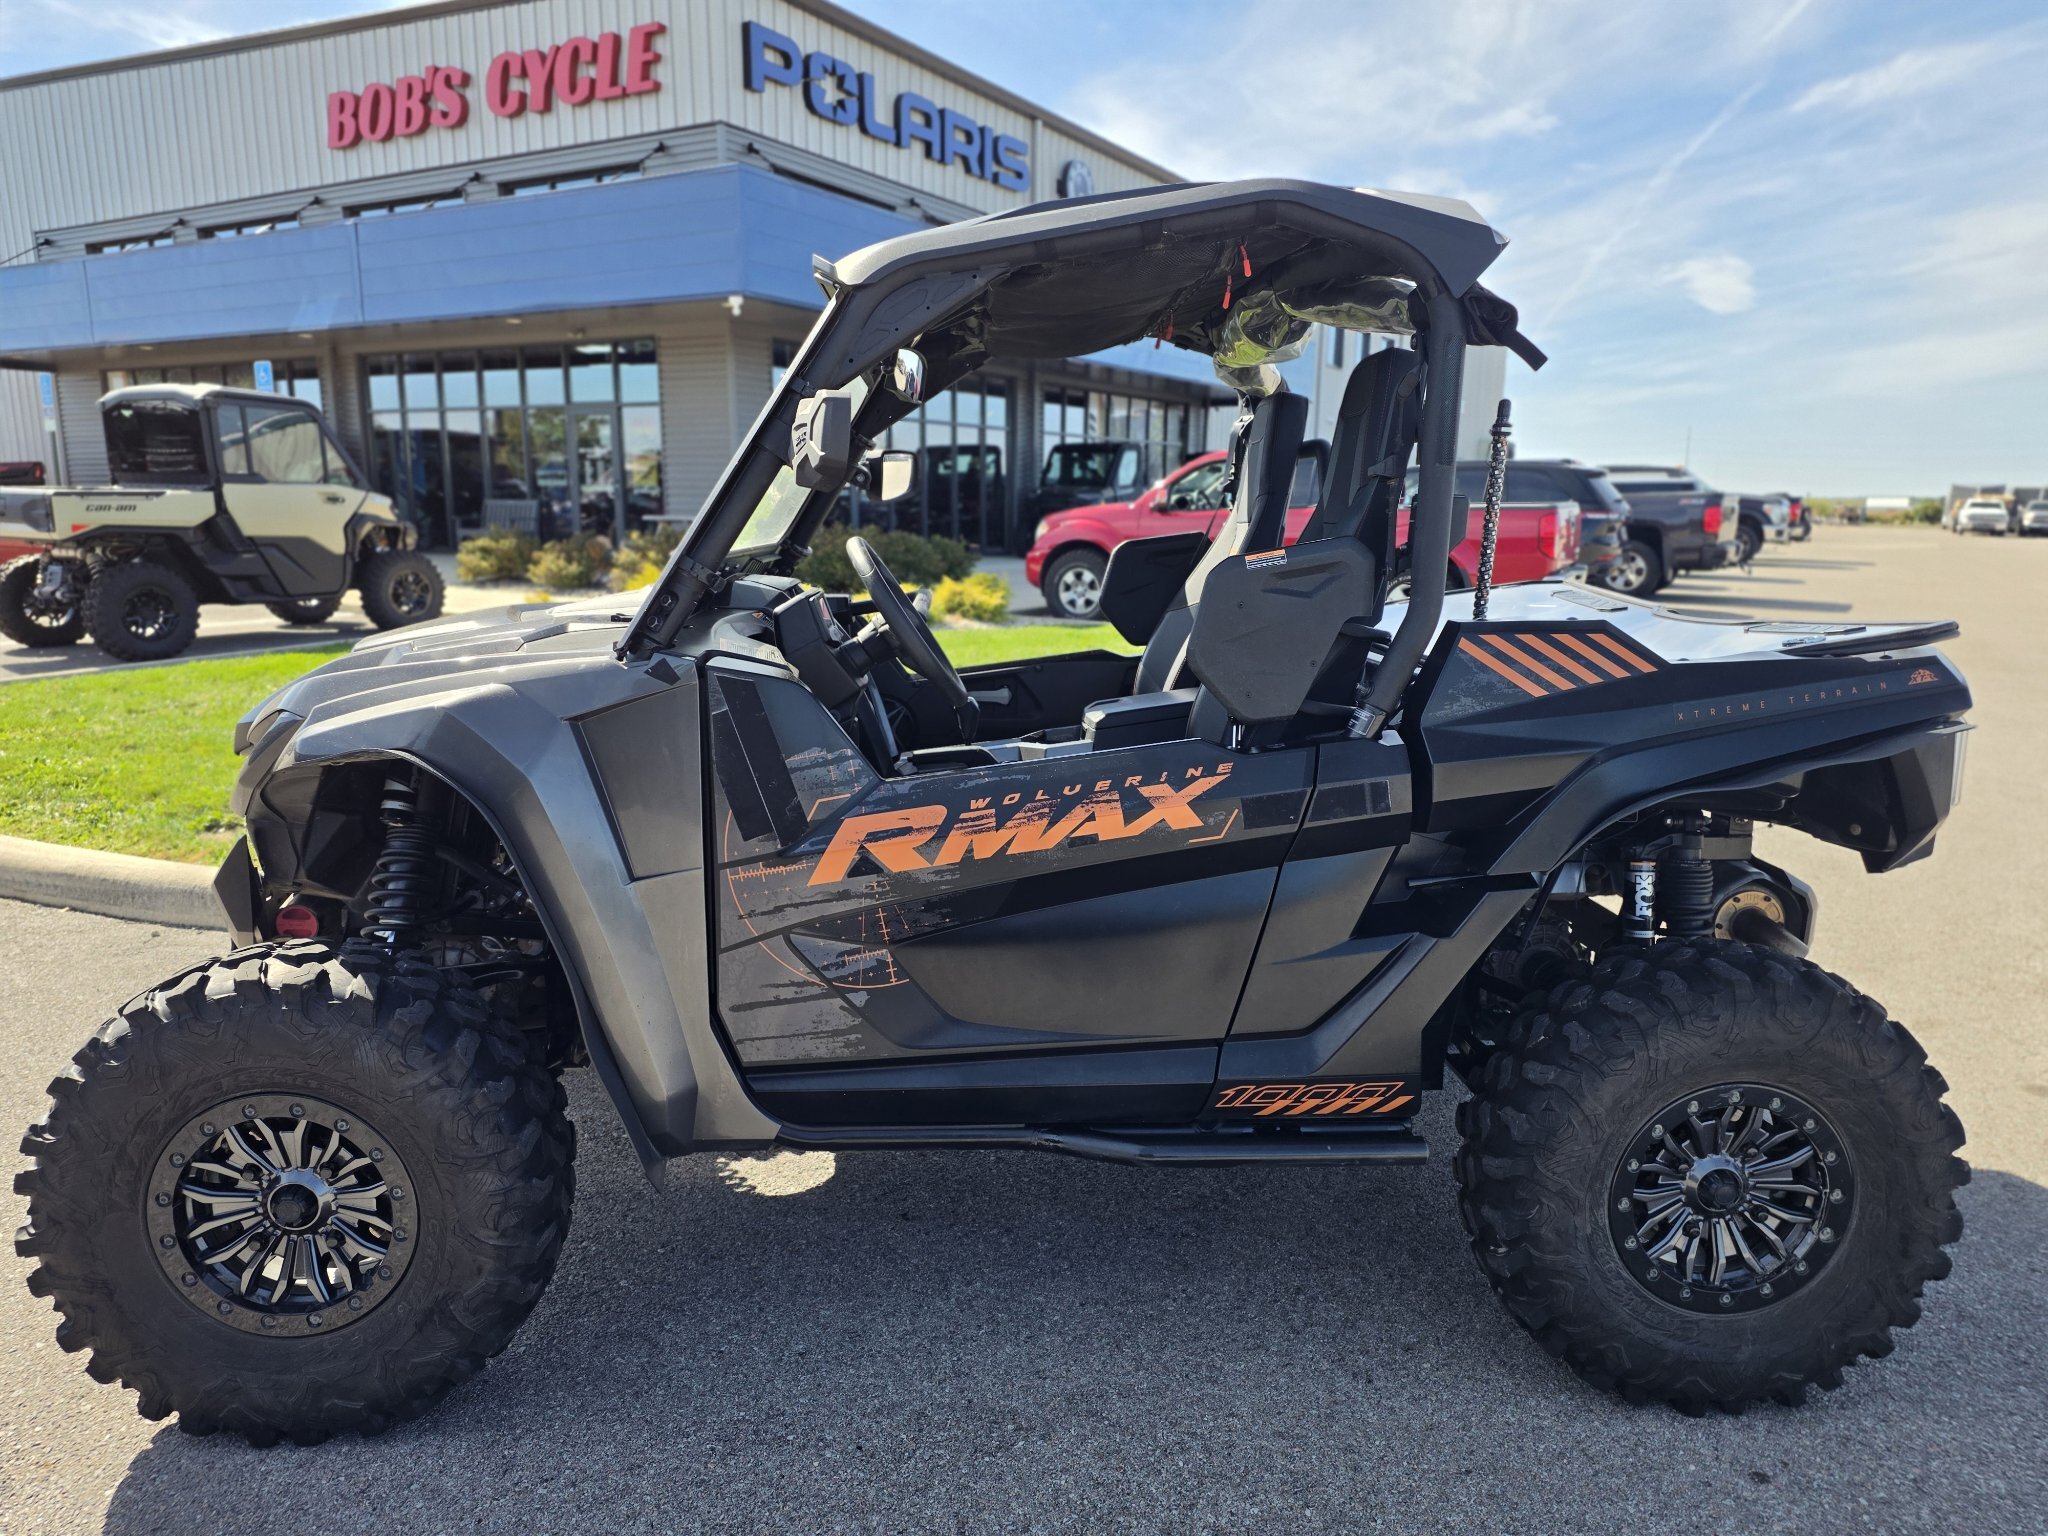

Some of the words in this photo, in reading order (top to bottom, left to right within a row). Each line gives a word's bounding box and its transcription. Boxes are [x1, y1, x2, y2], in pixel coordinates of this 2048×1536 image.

[327, 65, 471, 149] BOB'S
[485, 21, 667, 118] CYCLE
[742, 20, 1031, 193] POLARIS
[1677, 700, 1767, 721] XTREME
[1789, 681, 1888, 704] TERRAIN
[807, 773, 1231, 887] RMAX
[1634, 874, 1655, 917] FOX
